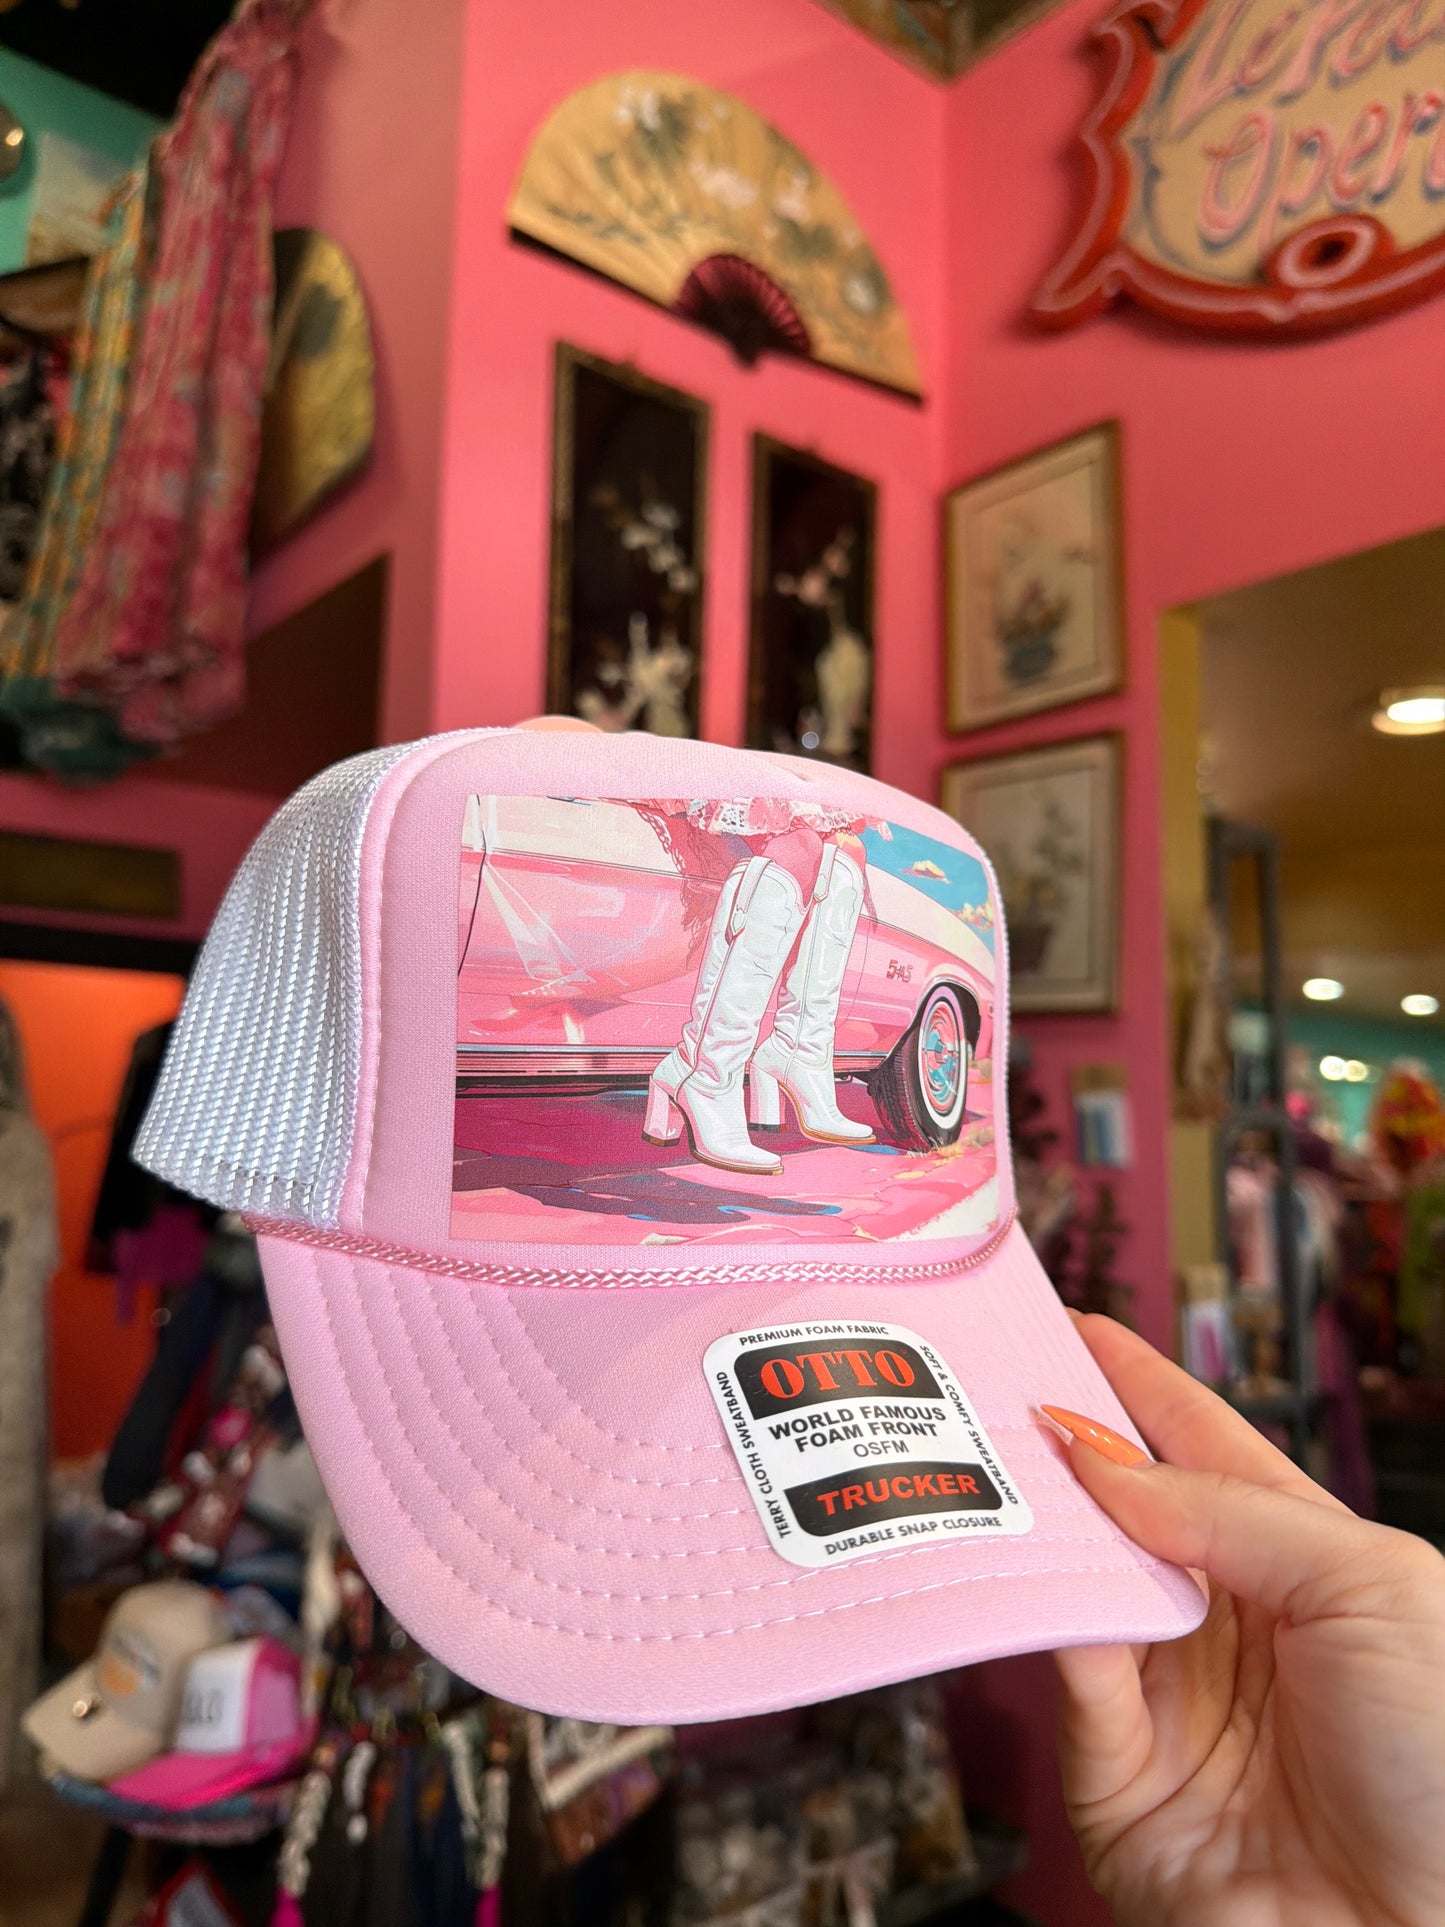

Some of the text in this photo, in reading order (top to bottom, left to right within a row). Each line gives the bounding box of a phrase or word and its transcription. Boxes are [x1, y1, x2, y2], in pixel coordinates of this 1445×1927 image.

[738, 1324, 889, 1346] PREMIUM FOAM FABRIC
[760, 1350, 915, 1399] OTTO
[768, 1405, 946, 1440] WORLD FAMOUS
[794, 1421, 938, 1453] FOAM FRONT
[919, 1344, 1018, 1505] SOFT & COMFY SWEATBAND
[716, 1371, 792, 1539] TERRY CLOTH SWEATBAND
[853, 1440, 910, 1458] OSFM
[817, 1473, 981, 1516] TRUCKER
[824, 1516, 1003, 1555] DURABLE SNAP CLOSURE
